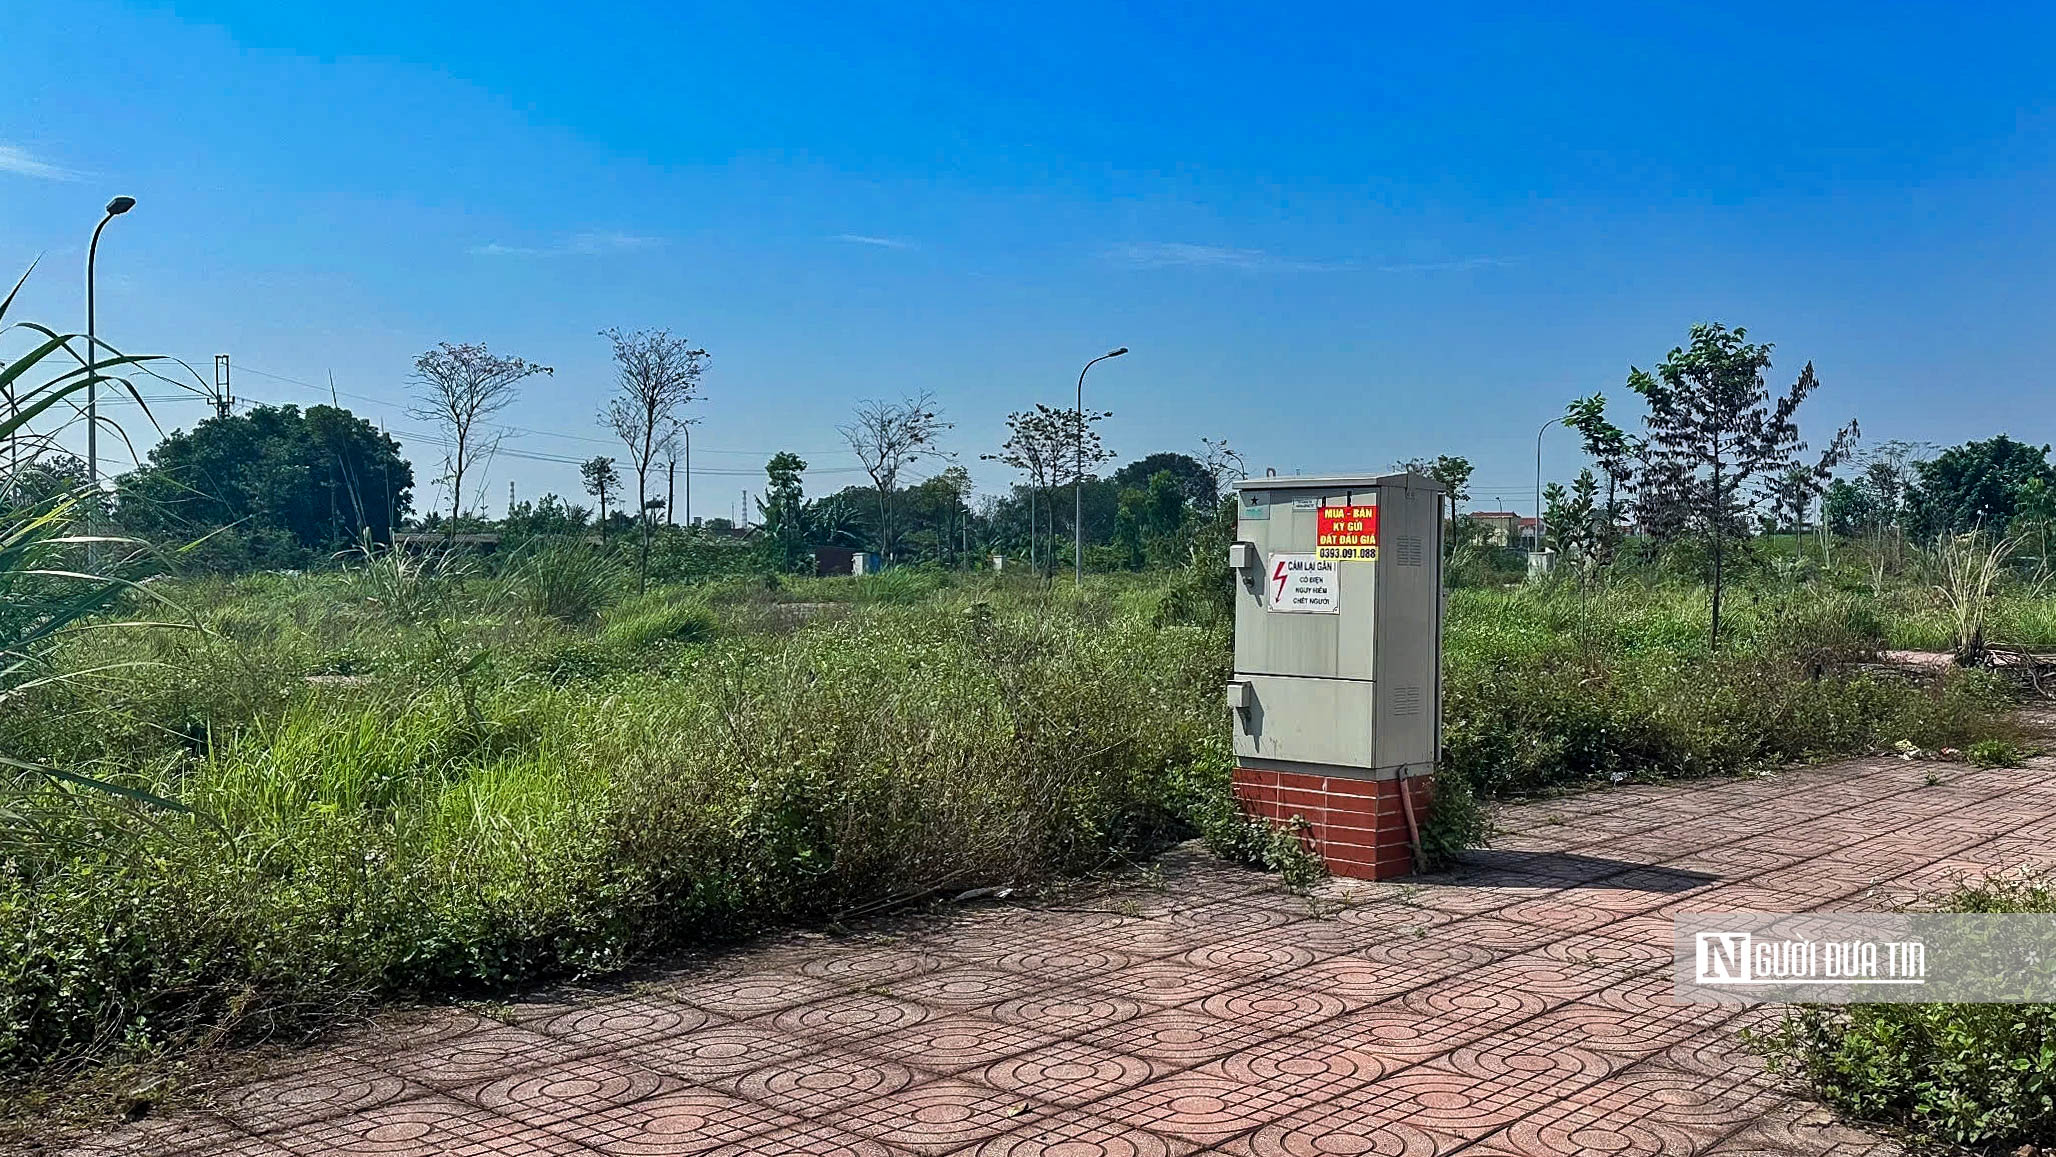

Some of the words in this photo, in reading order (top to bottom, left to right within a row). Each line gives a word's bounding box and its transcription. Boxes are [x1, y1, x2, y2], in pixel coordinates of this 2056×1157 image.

[1325, 509, 1344, 518] MUA
[1353, 507, 1373, 518] BÁN
[1320, 532, 1337, 545] ĐẤT
[1339, 531, 1358, 545] ĐẤU
[1360, 532, 1376, 545] GIÁ
[1320, 548, 1376, 558] 0393.091.088
[1304, 562, 1316, 574] LẠI
